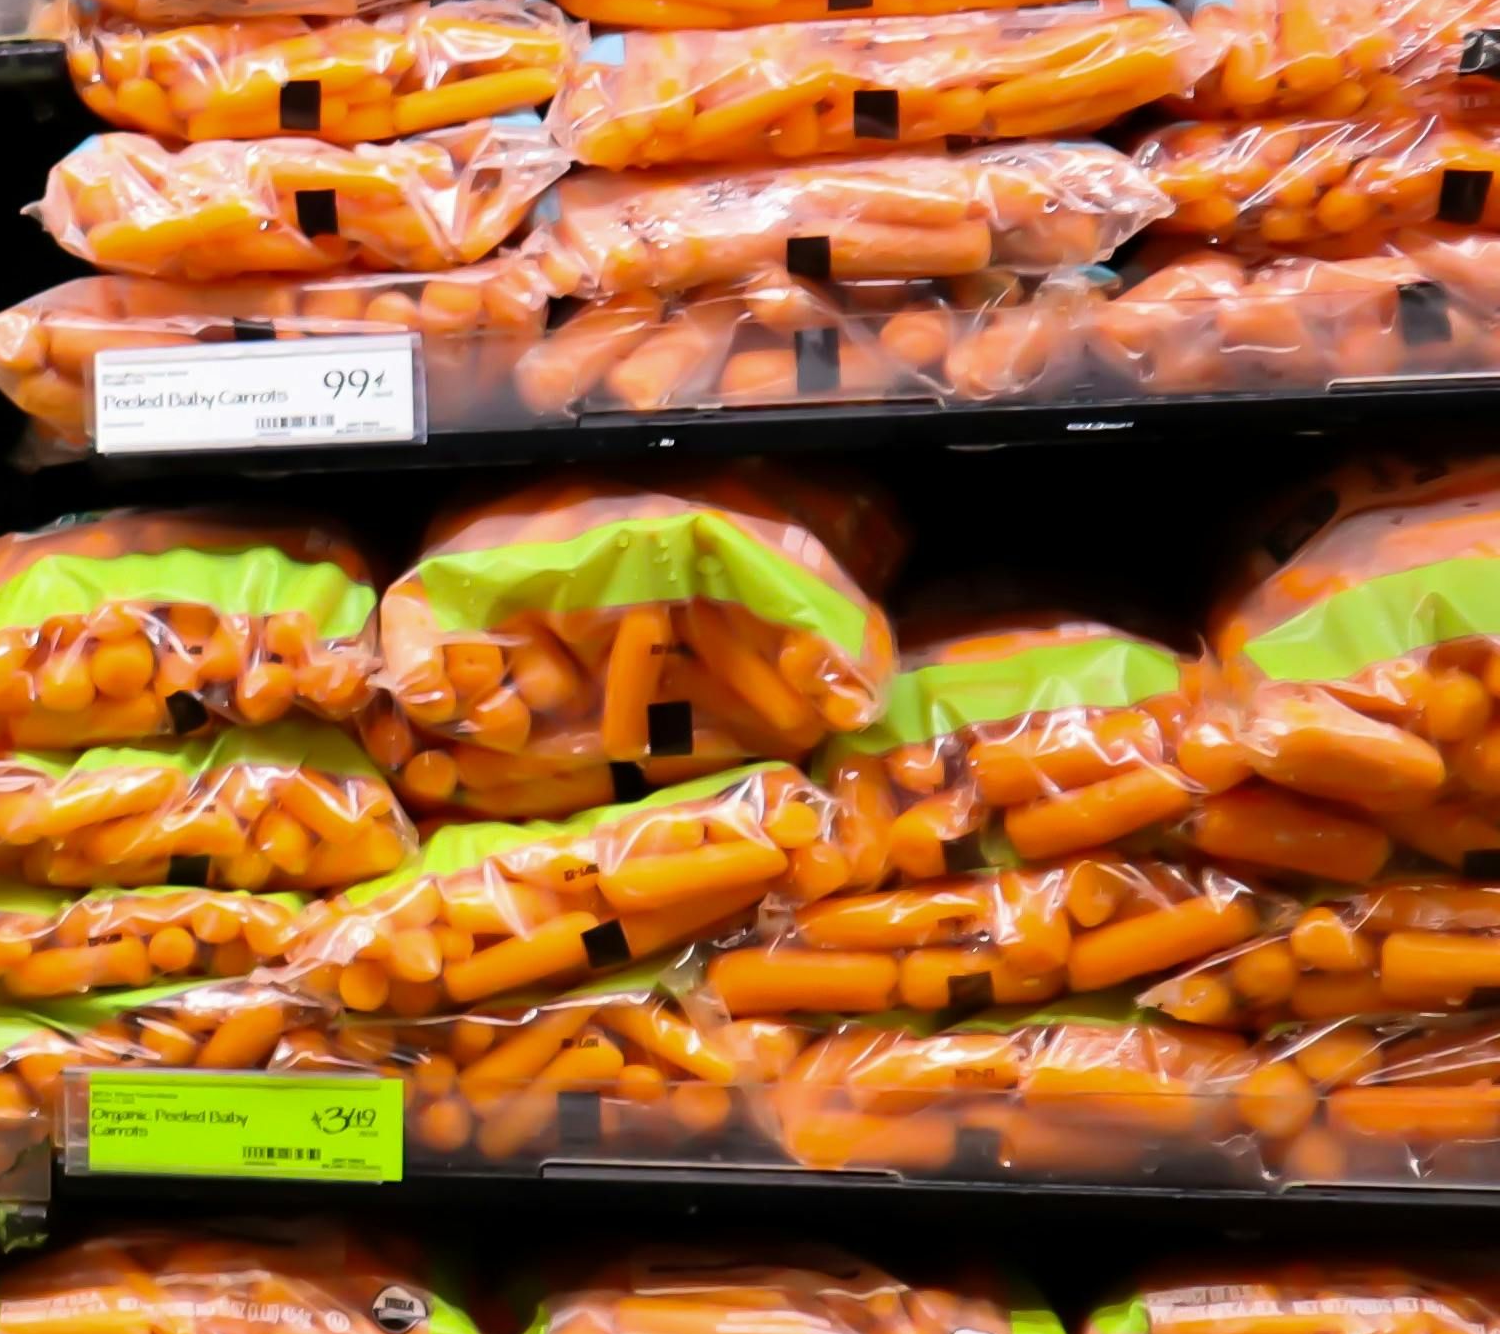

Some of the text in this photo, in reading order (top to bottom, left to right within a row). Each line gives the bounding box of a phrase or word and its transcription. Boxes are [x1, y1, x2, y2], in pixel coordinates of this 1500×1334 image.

[103, 389, 289, 411] Peeled Baby Carrots
[90, 1107, 249, 1128] Organic Peeled Baby
[90, 1125, 149, 1138] Carrots
